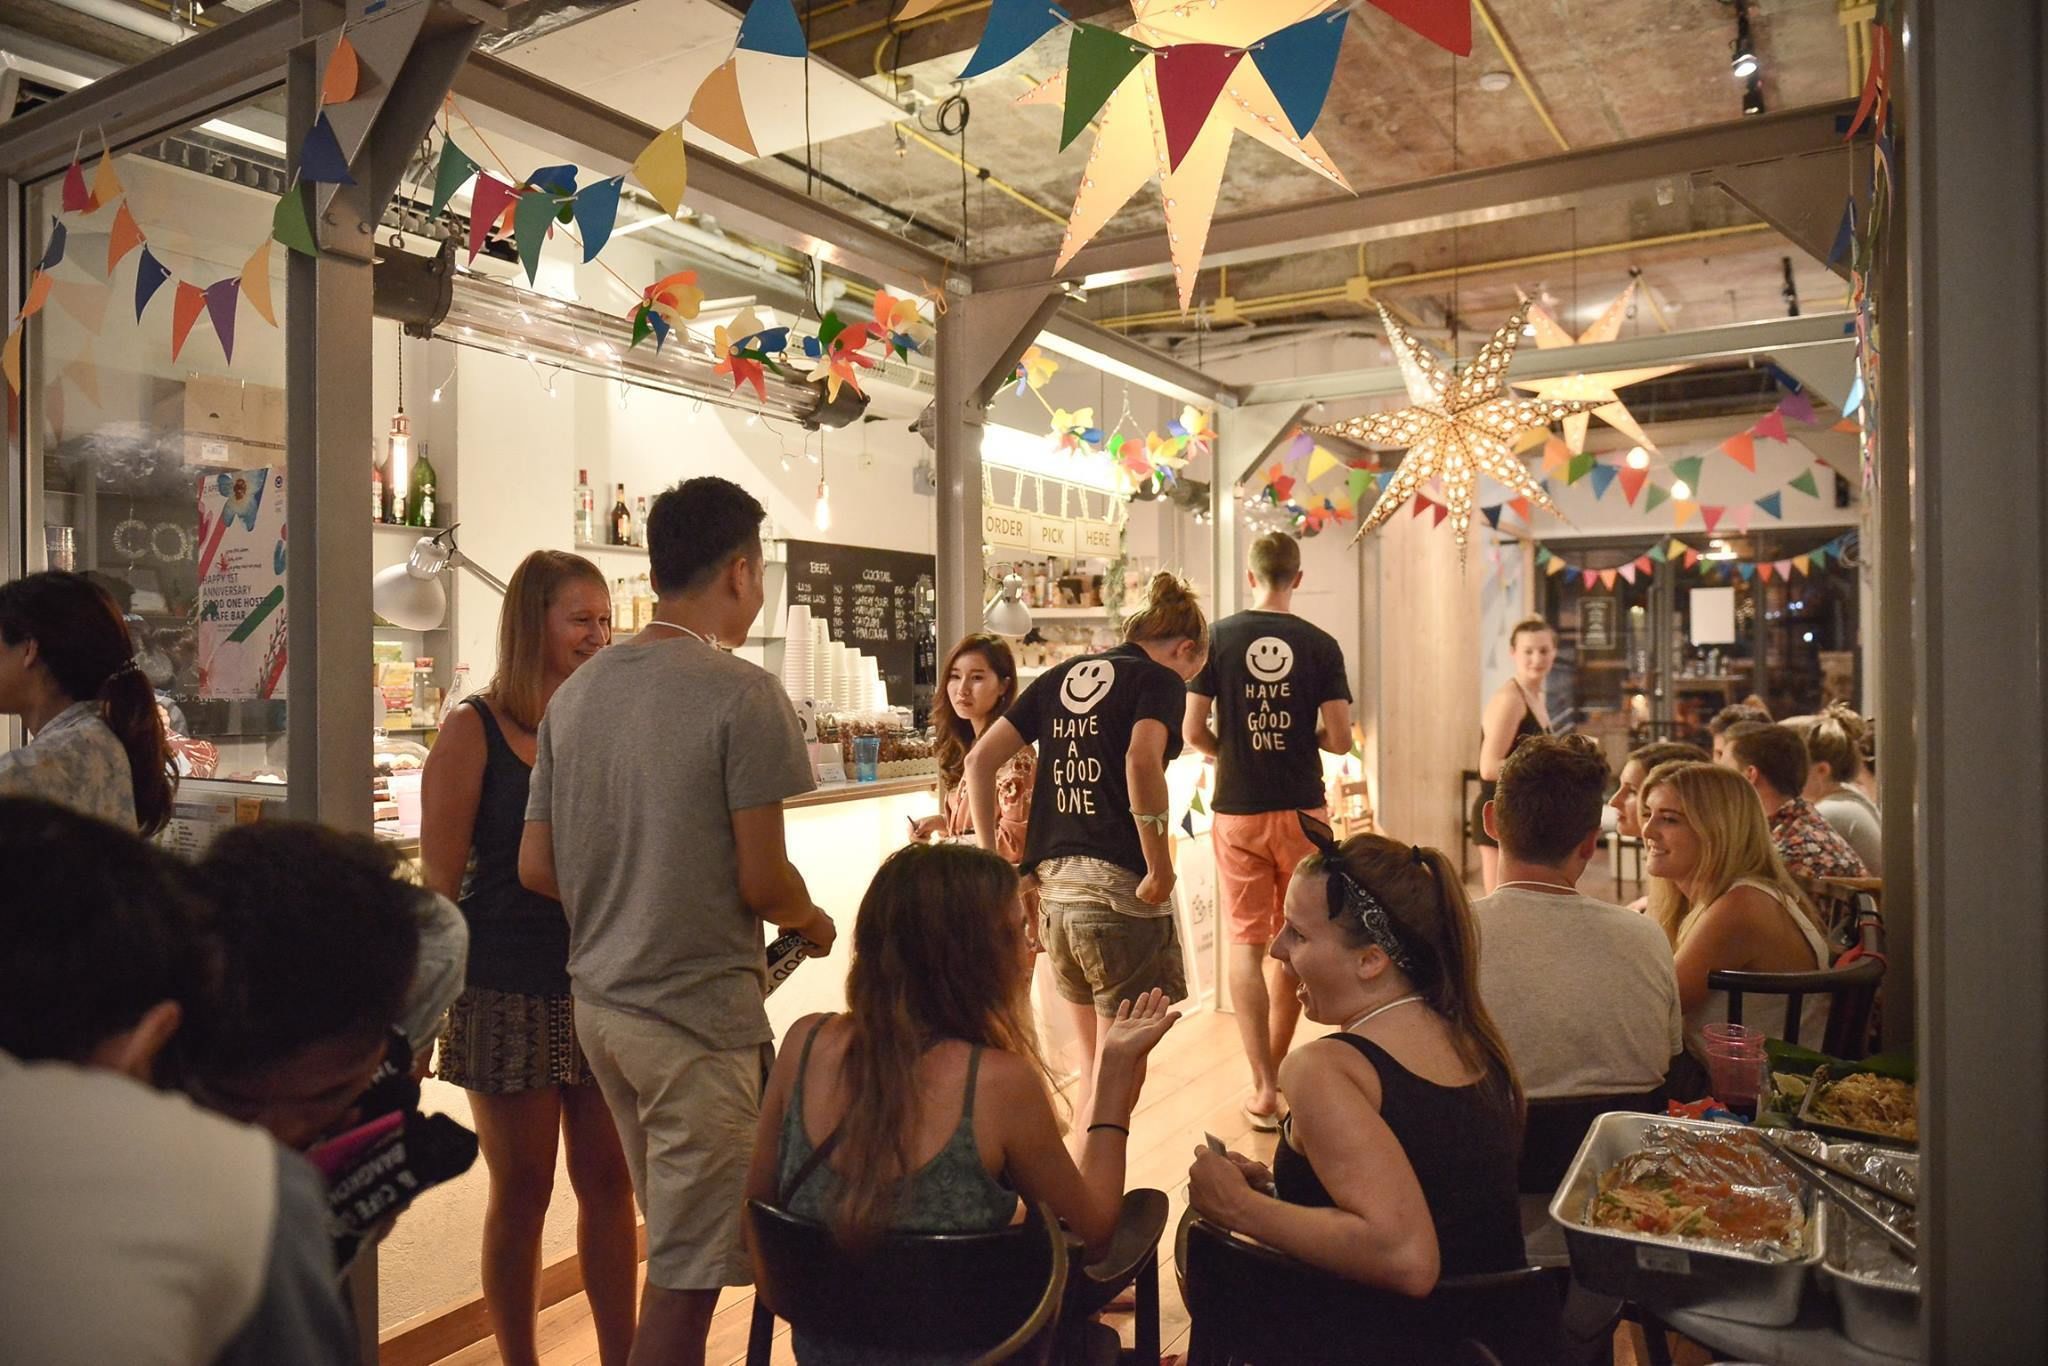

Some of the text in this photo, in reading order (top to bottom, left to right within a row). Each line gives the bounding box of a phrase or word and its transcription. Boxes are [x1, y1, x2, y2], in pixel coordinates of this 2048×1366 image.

[986, 516, 1110, 547] ORDER PICK HERE
[203, 573, 238, 584] HAPPY 1ST
[203, 585, 251, 597] ANNIVERSARY
[203, 599, 225, 609] GOD
[226, 598, 242, 609] ONE
[230, 610, 246, 621] BAR
[1245, 682, 1291, 699] HAVE
[1260, 700, 1270, 712] A
[1053, 715, 1099, 738] HAVE
[1247, 711, 1291, 731] GOOD
[1068, 740, 1079, 758] A
[1252, 732, 1286, 750] ONE
[1053, 757, 1102, 786] GOOD
[1057, 787, 1097, 815] ONE
[773, 936, 806, 957] OSTEL
